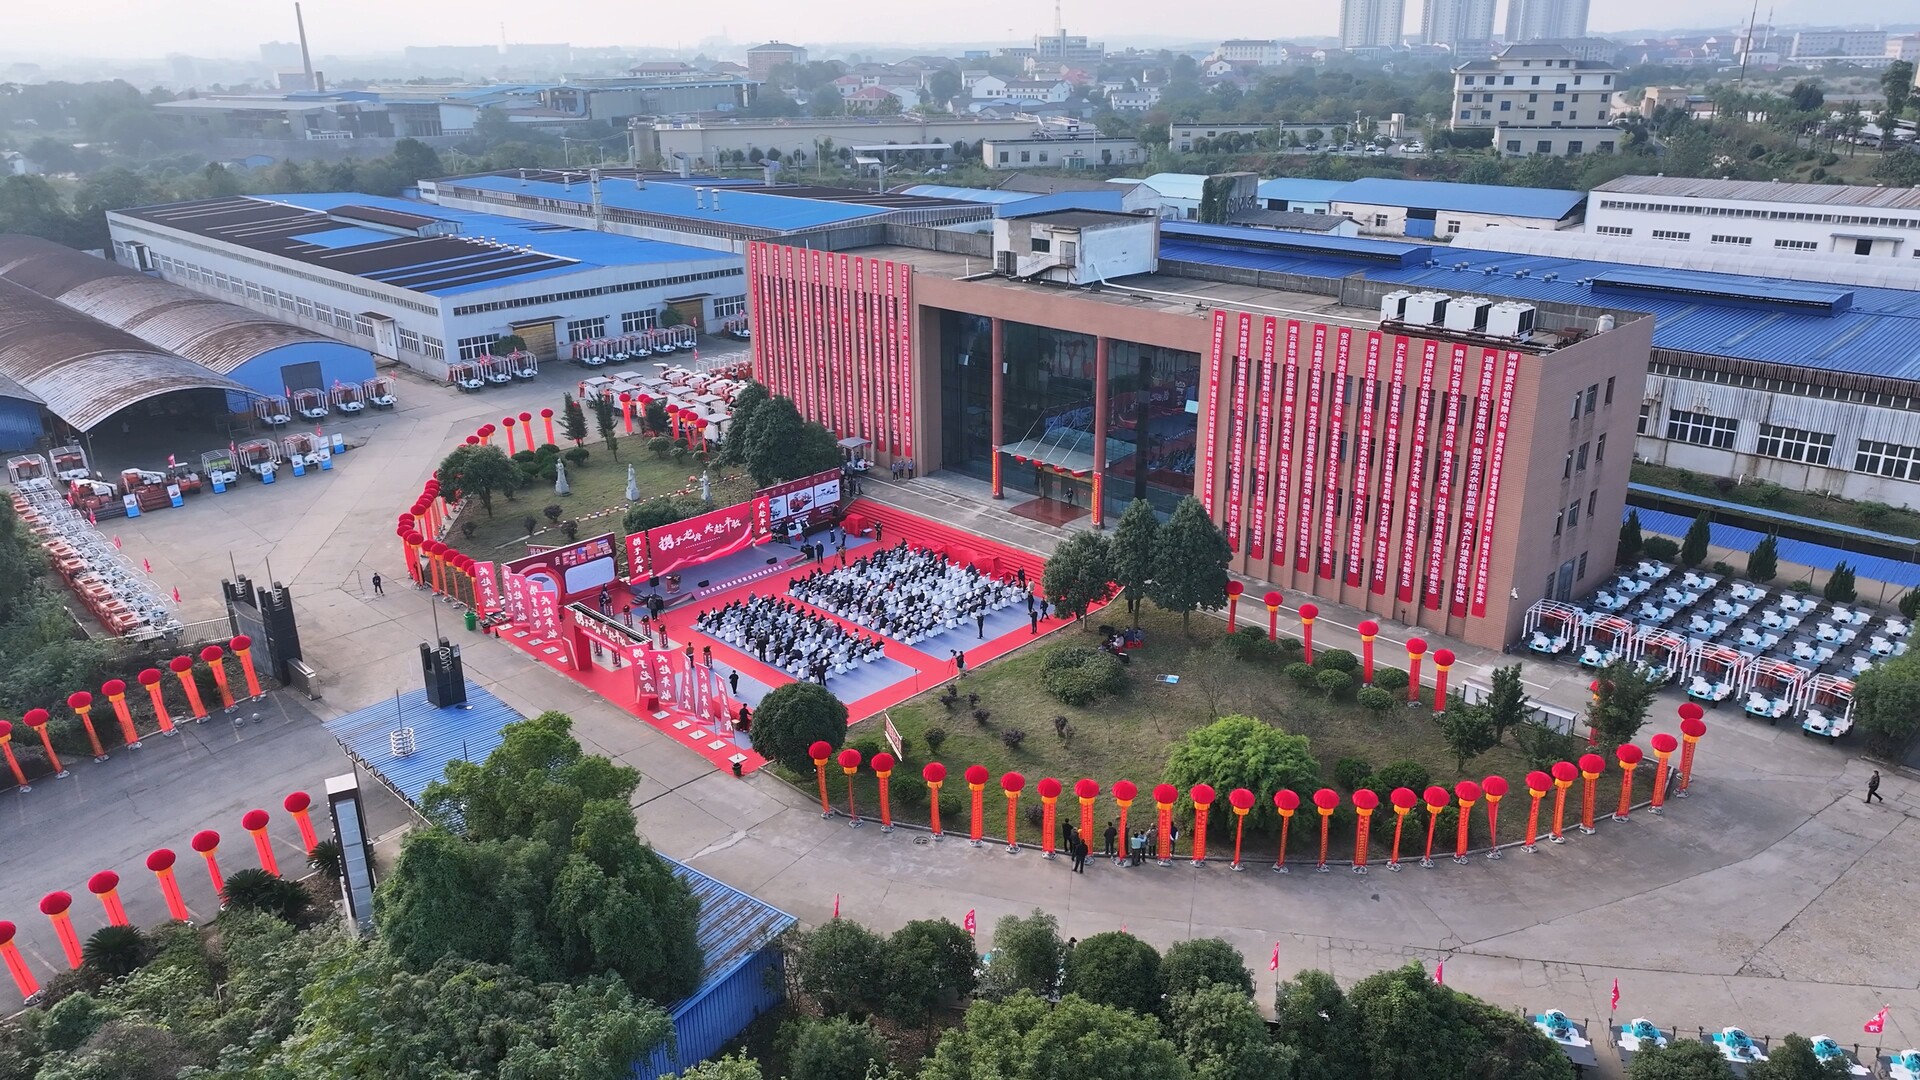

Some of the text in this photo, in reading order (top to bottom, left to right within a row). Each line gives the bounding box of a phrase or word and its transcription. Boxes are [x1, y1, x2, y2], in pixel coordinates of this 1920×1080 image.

[1282, 406, 1291, 450] 携手龙舟农机
[1411, 445, 1422, 488] 携手龙舟农机
[1440, 451, 1451, 493] 携手龙舟农机
[658, 528, 703, 552] 携手龙舟
[703, 516, 742, 535] 共赴丰收
[757, 500, 768, 535] 共赴丰收
[632, 536, 645, 574] 携手龙舟
[1455, 522, 1472, 603] 为农户打造高效耕作新体验
